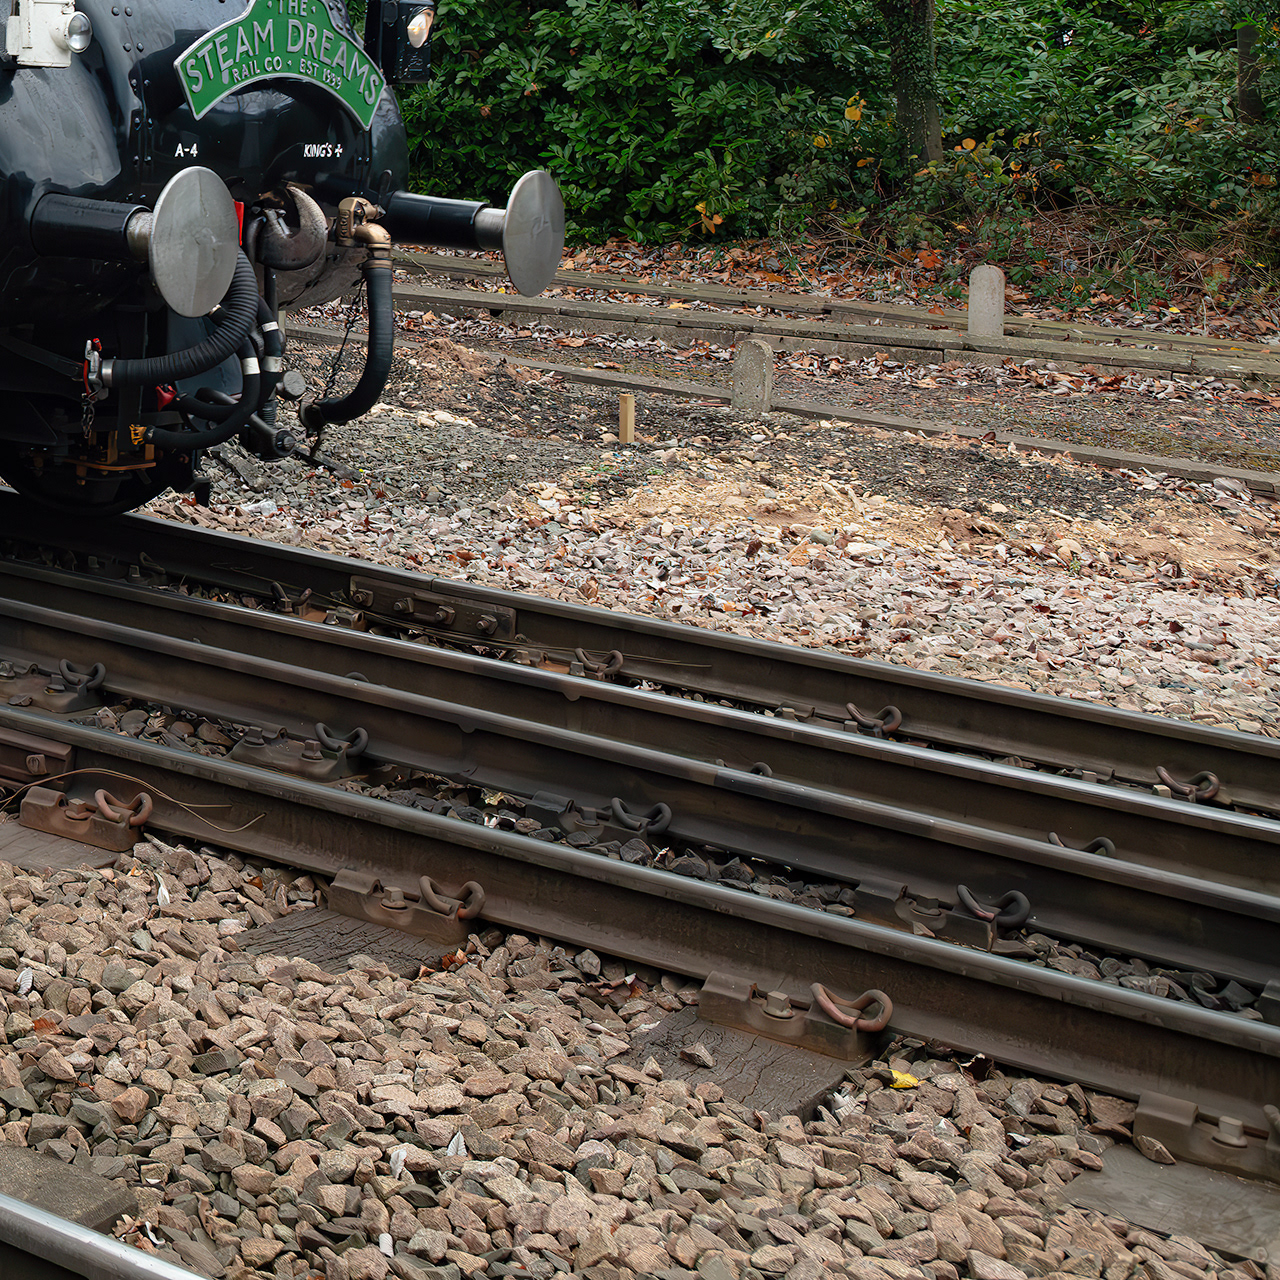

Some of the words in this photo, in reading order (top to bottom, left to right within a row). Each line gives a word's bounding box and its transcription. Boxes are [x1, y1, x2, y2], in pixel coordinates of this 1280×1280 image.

[186, 19, 275, 93] STEAM
[287, 19, 380, 105] DREAMS
[231, 59, 261, 83] RAIL
[264, 56, 282, 72] CO
[299, 58, 320, 77] EST
[322, 68, 342, 90] 1999
[174, 142, 199, 158] A-4
[303, 142, 333, 158] KING'S
